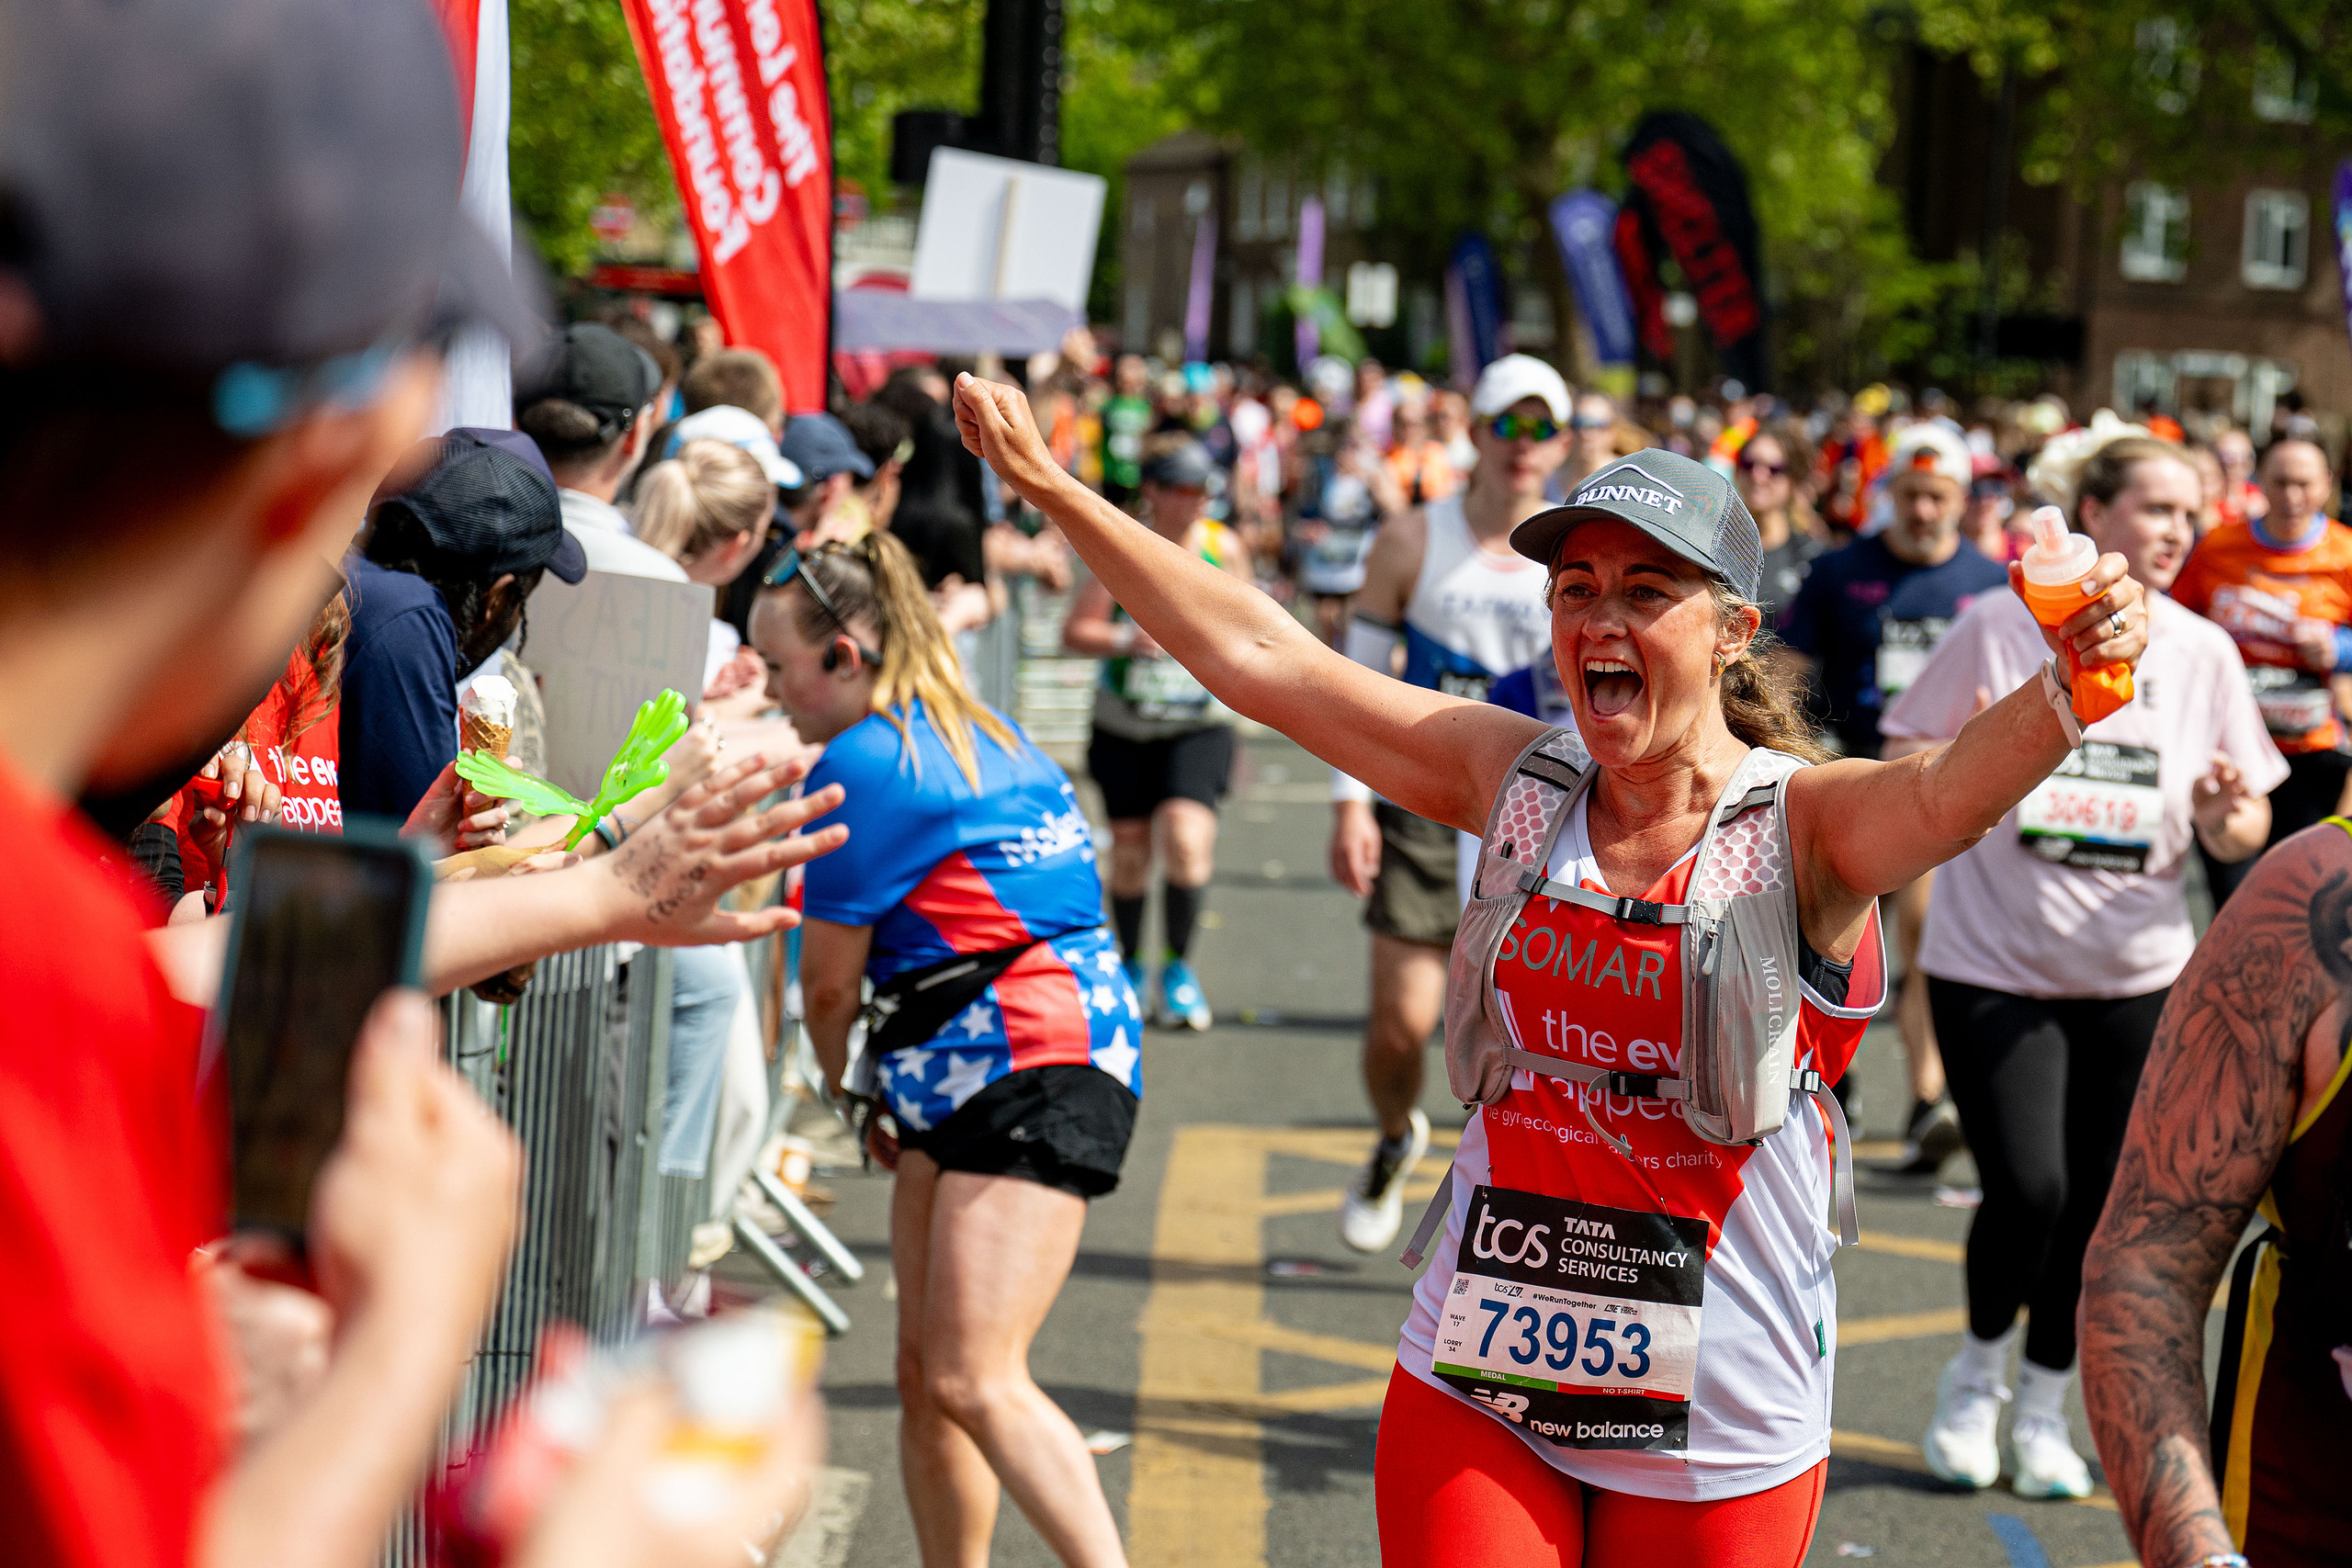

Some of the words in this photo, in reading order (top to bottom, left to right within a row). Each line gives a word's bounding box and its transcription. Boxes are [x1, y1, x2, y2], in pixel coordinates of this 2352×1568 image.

[1574, 484, 1682, 515] BUNNET
[1497, 916, 1666, 1000] SOMAR
[1759, 955, 1782, 1085] MOLICRAIN
[1542, 1009, 1618, 1063] the
[1666, 1150, 1723, 1169] charity
[1473, 1203, 1551, 1269] tcs
[1564, 1216, 1616, 1240] TATA
[1560, 1237, 1689, 1269] CONSULTANCY
[1557, 1258, 1639, 1283] SERVICES
[1532, 1292, 1597, 1310] #WeRunTogether
[1450, 1314, 1466, 1322] WAVE
[1443, 1338, 1463, 1348] LORRY
[1478, 1298, 1652, 1379] 73953
[1480, 1370, 1507, 1382] MEDAL
[1530, 1419, 1572, 1438] new
[1577, 1421, 1665, 1439] balance
